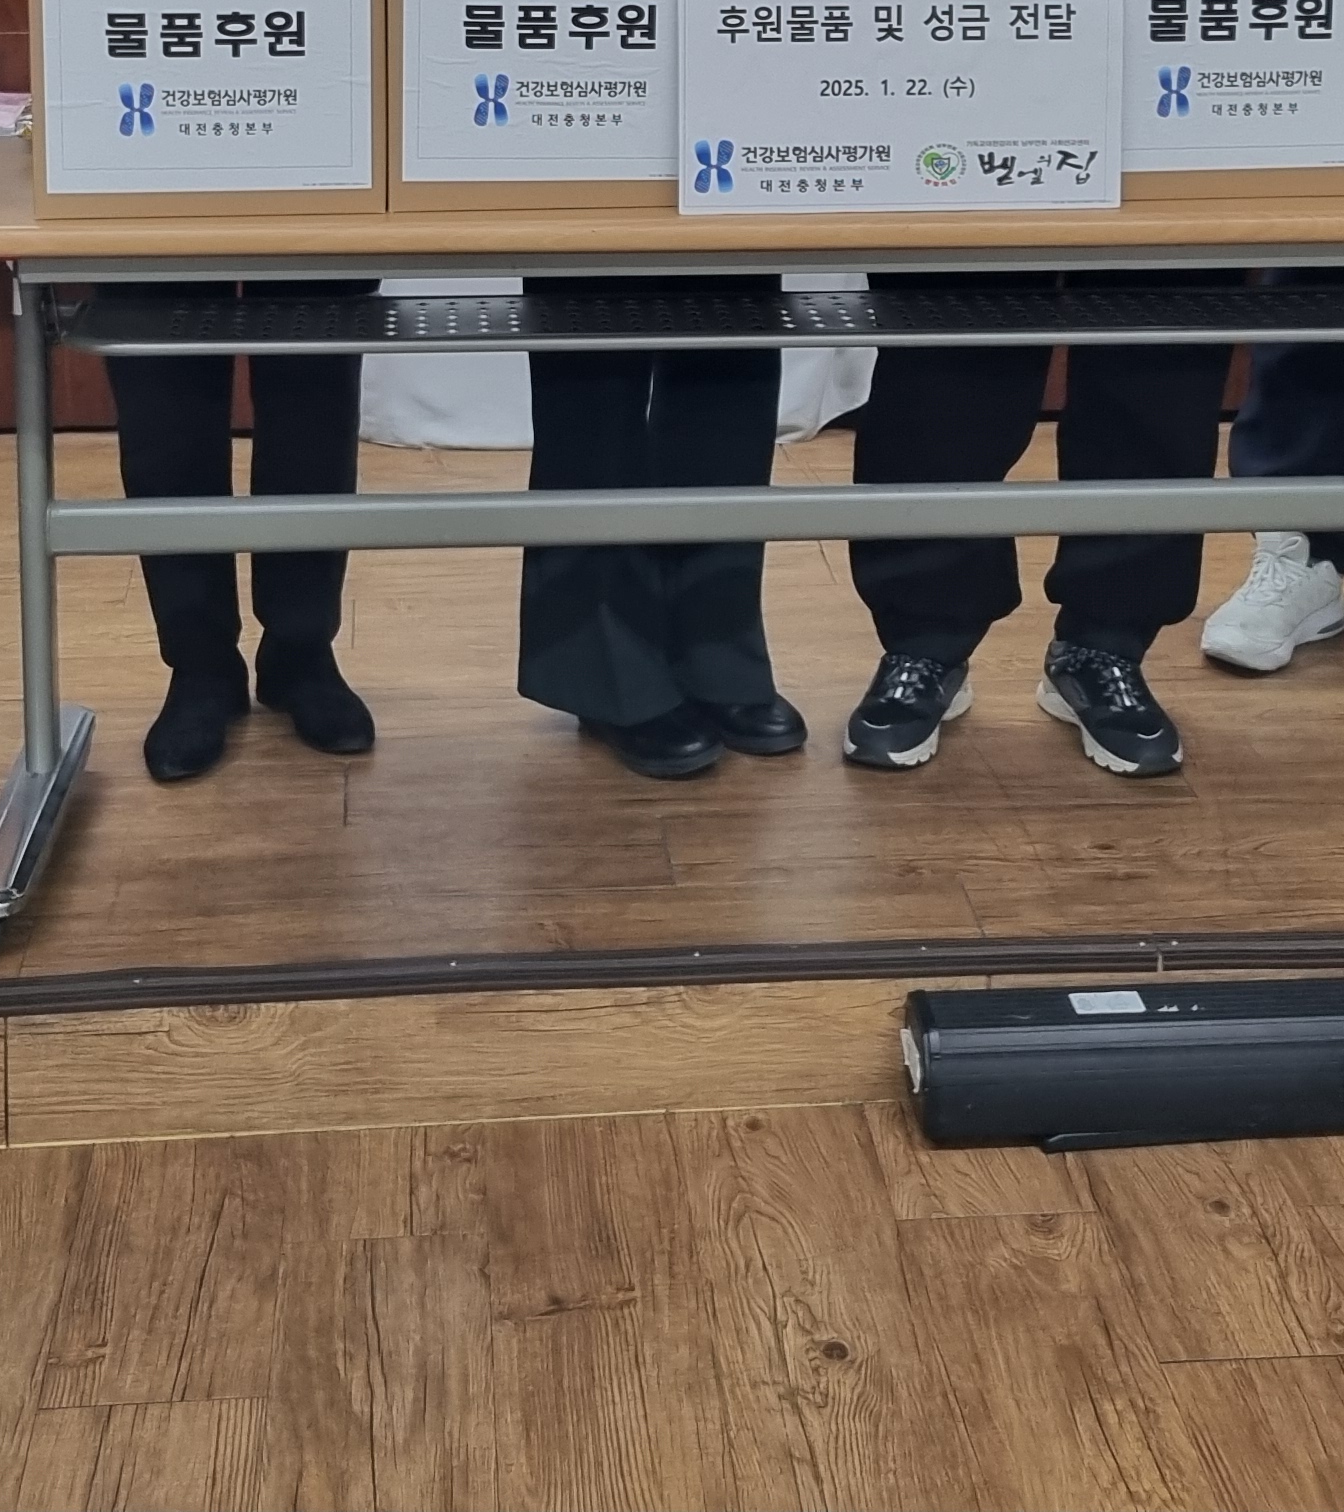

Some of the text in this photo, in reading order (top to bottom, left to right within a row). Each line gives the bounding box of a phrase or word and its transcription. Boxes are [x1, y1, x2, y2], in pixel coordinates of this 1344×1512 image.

[463, 4, 657, 50] 물품후원
[716, 3, 1077, 44] 후원물품 및 성금 전달
[105, 10, 306, 58] 물품후원
[516, 80, 647, 98] 건강보험심사평가원
[820, 76, 975, 99] 2025. 1. 22. (수)
[1197, 70, 1323, 89] 건강보험심사평가원
[161, 88, 297, 108] 건강보험심사평가원
[1211, 102, 1298, 117] 대전충청본부
[179, 122, 273, 137] 대전충청본부
[531, 113, 623, 127] 대전충청본부
[741, 144, 891, 163] 건강보험심사평가원
[760, 178, 864, 193] 대전충청본부
